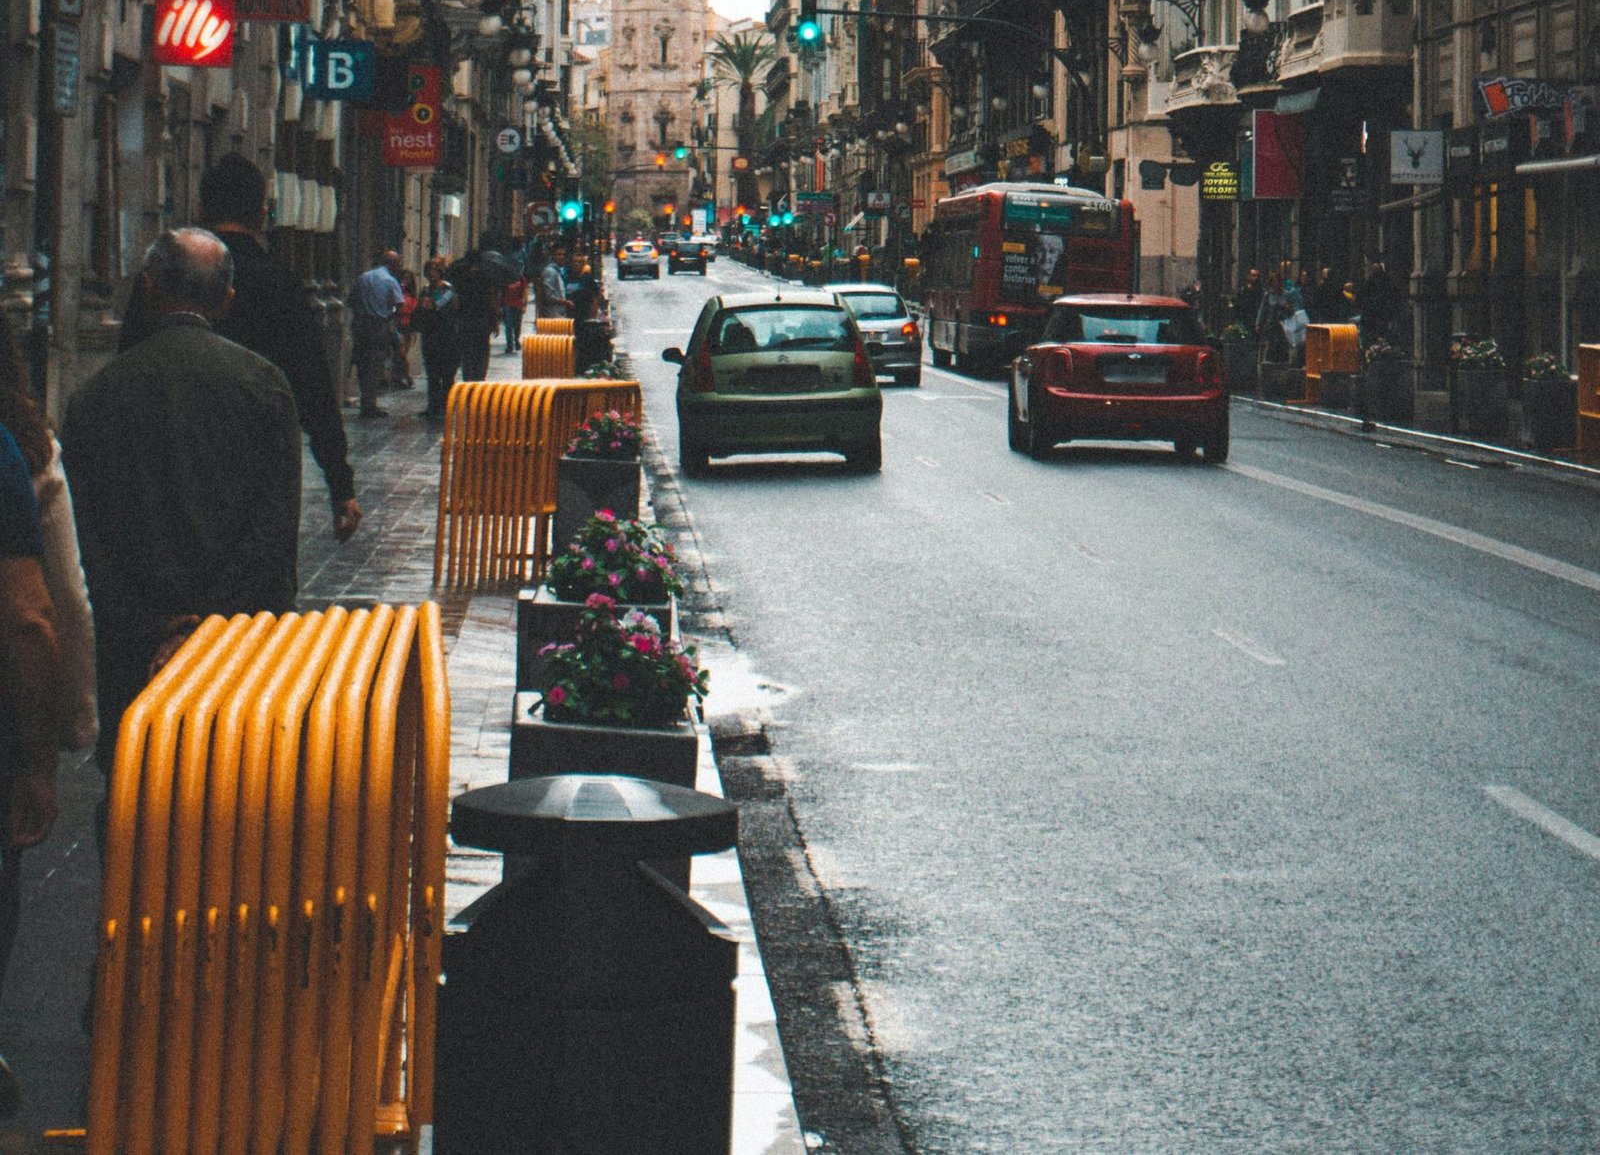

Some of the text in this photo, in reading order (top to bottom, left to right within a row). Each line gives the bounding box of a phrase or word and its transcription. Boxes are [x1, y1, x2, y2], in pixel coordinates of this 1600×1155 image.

[328, 52, 354, 88] B
[391, 132, 434, 147] nest
[1203, 186, 1238, 194] RELOJES
[1005, 254, 1028, 264] volver
[1004, 264, 1029, 274] contar
